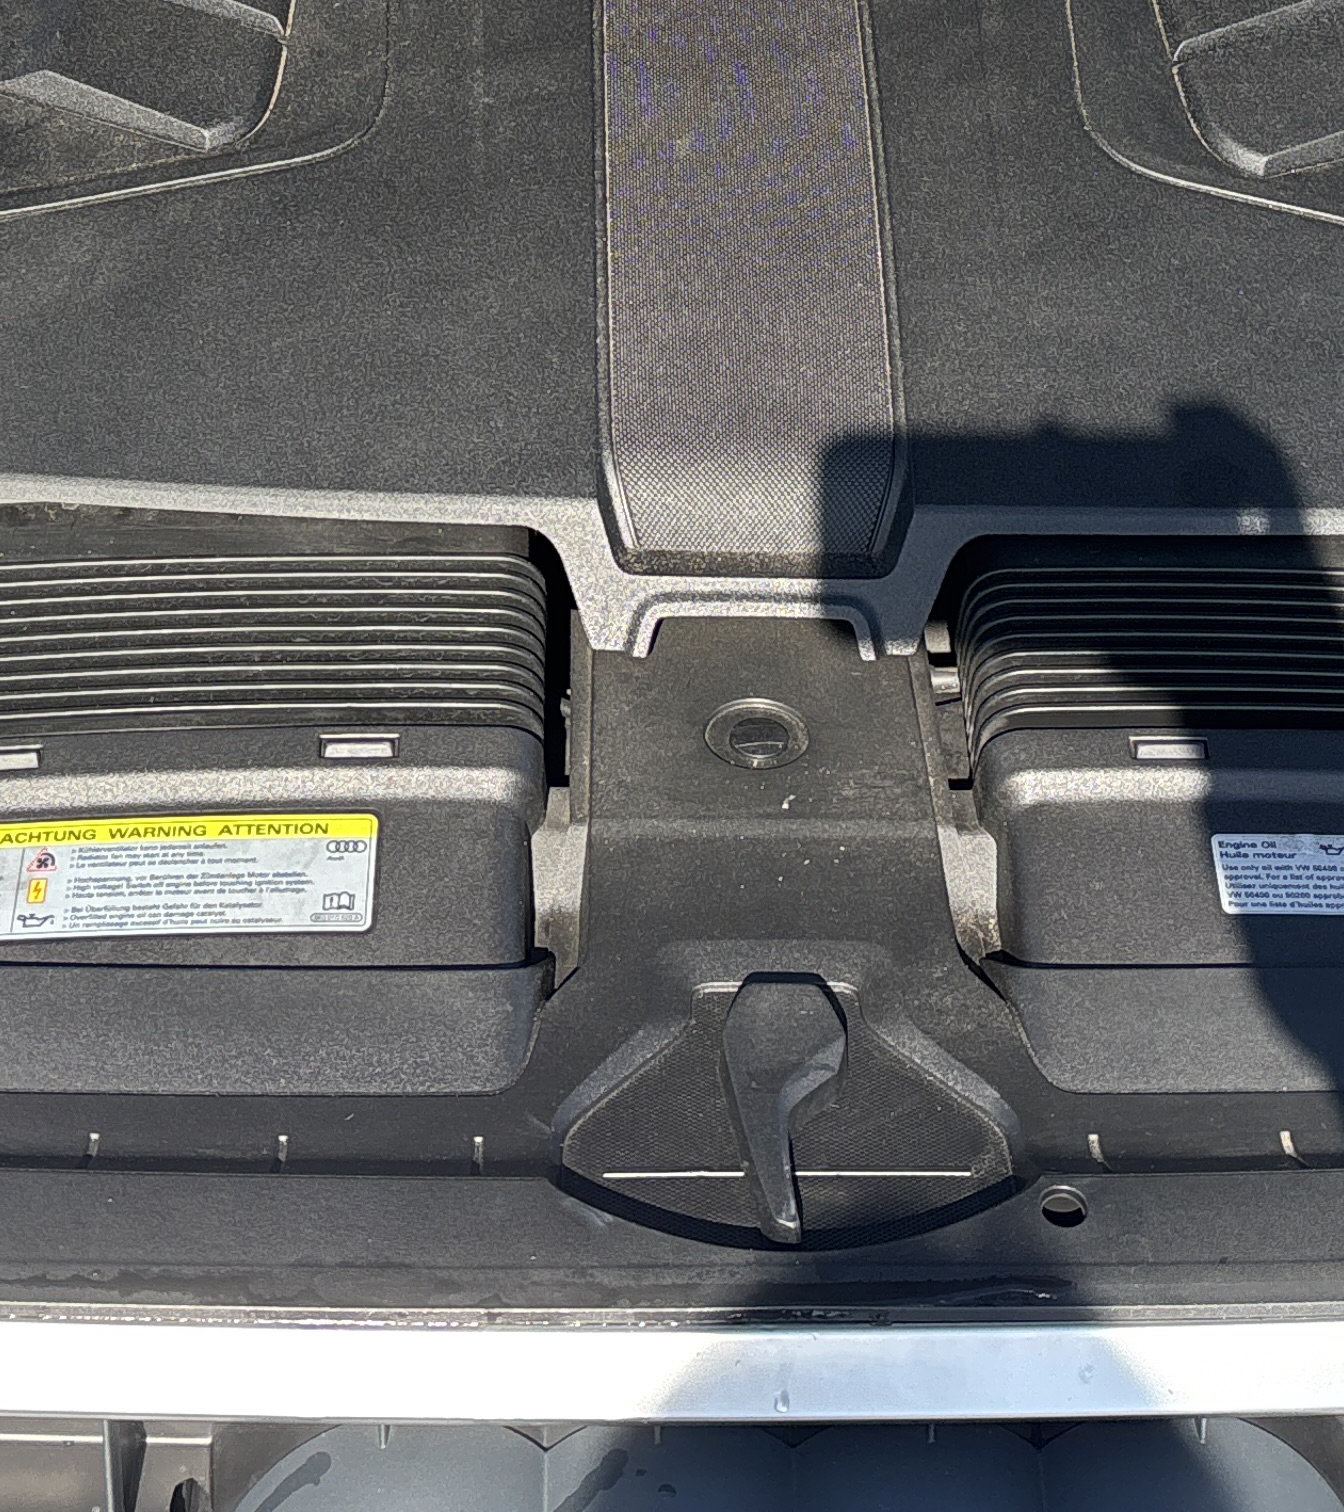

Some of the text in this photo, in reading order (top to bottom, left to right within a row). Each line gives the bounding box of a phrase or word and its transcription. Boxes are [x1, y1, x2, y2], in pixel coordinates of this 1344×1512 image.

[0, 822, 329, 845] ACHTUNG WARNING ATTENTION
[1218, 841, 1257, 849] Engine
